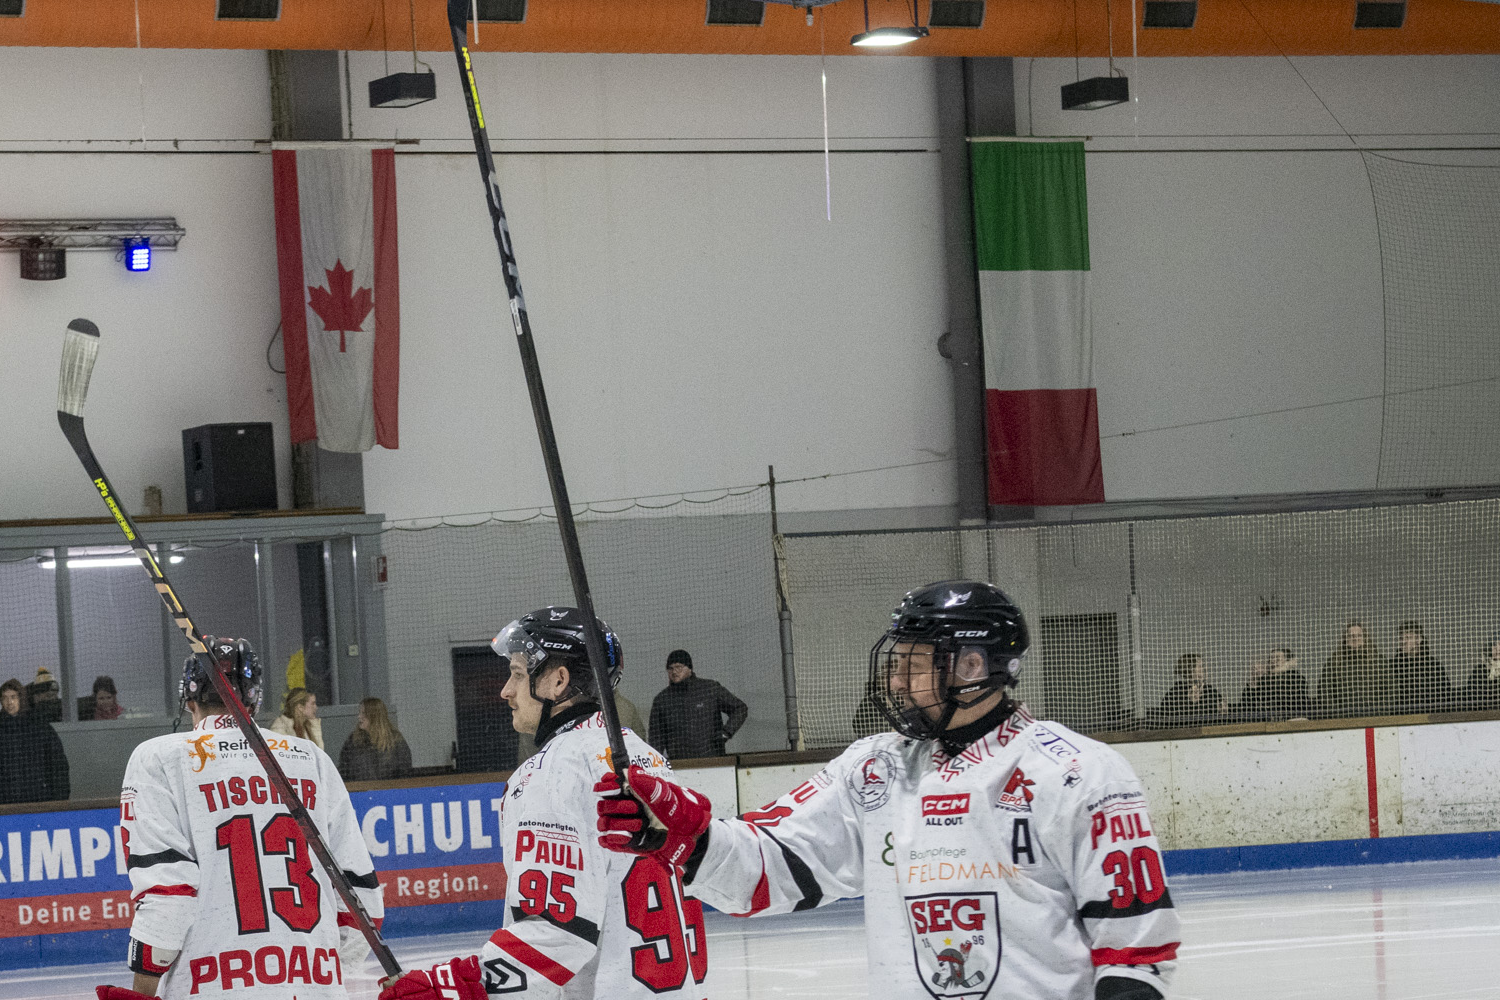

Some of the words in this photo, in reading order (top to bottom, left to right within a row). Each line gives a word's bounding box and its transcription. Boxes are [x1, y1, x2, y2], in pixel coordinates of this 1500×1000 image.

[544, 641, 572, 650] CCM
[954, 630, 989, 638] CCM
[959, 685, 981, 694] CCM
[924, 799, 969, 812] CCM
[925, 818, 943, 827] ALL
[515, 829, 585, 871] PAULI
[1012, 818, 1036, 865] A
[216, 813, 322, 936] 13
[398, 872, 489, 900] Region.
[1101, 845, 1166, 909] 30
[518, 868, 578, 924] 95
[18, 902, 92, 925] Deine
[910, 898, 986, 935] SEG
[972, 935, 985, 945] 96
